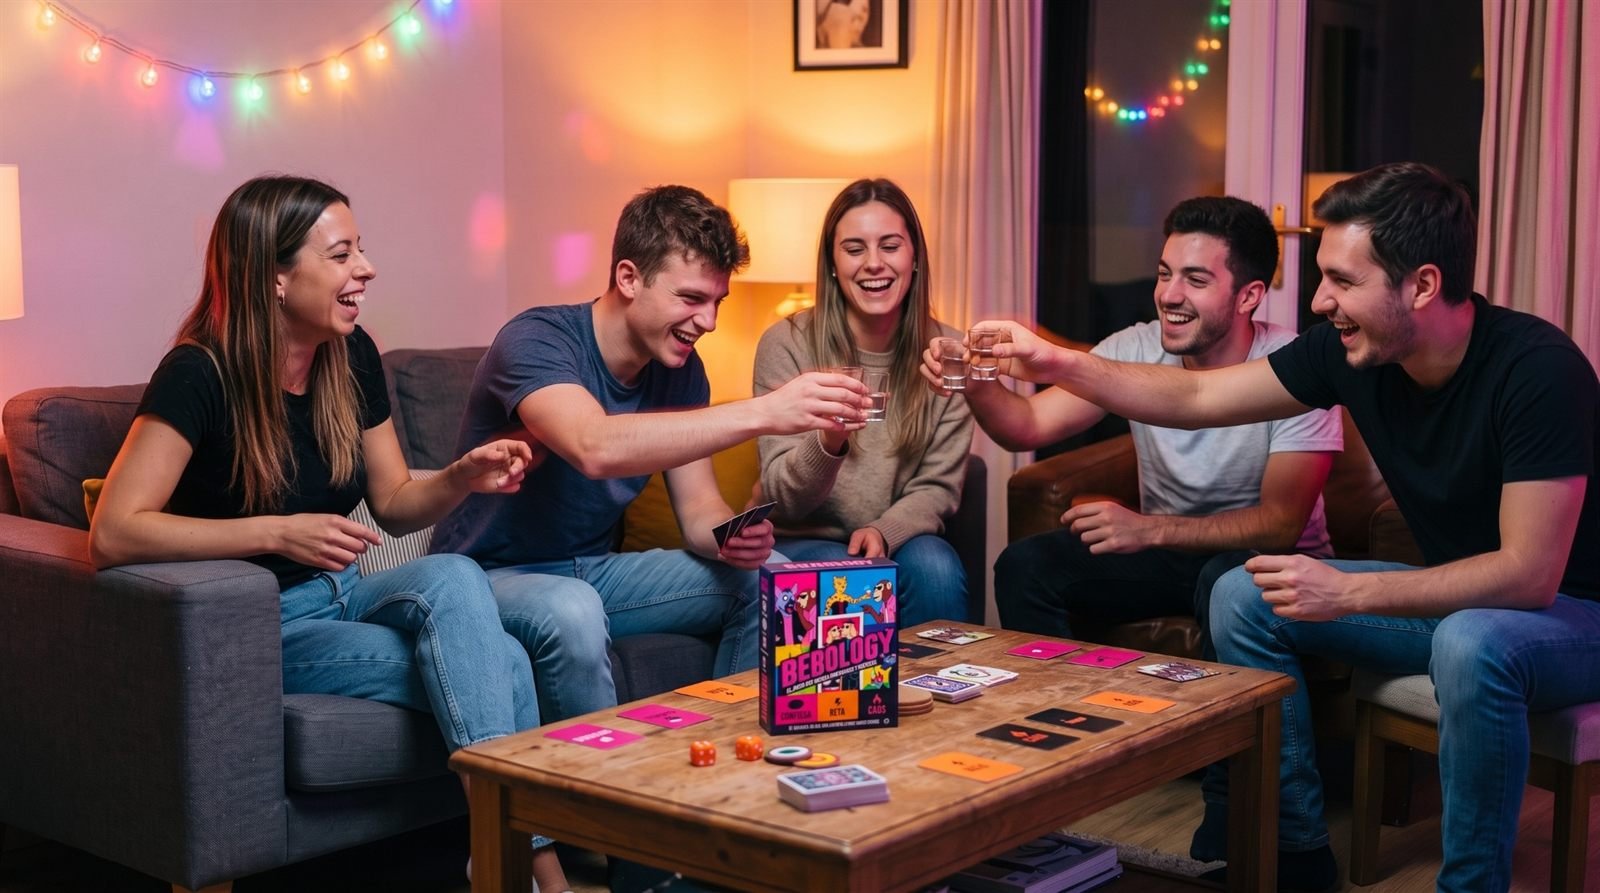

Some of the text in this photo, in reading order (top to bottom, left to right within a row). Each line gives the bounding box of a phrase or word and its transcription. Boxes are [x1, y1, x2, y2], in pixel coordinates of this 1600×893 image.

[781, 629, 894, 688] BEBOLOGY
[829, 707, 845, 717] RETA
[867, 705, 886, 715] CAOS
